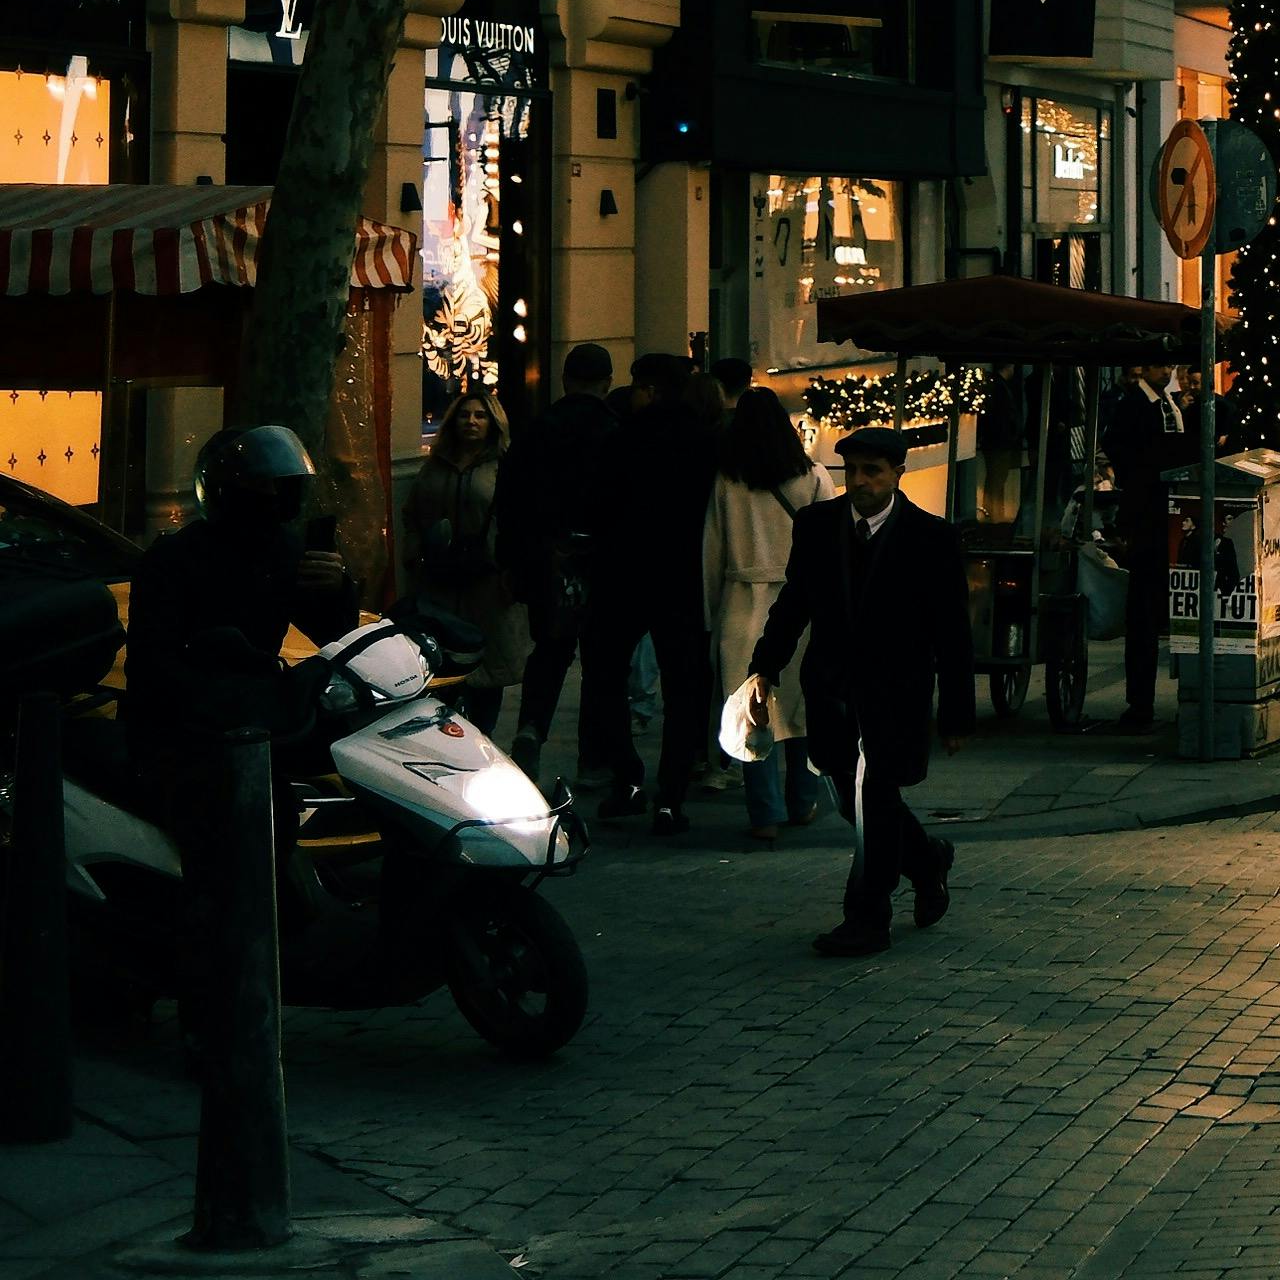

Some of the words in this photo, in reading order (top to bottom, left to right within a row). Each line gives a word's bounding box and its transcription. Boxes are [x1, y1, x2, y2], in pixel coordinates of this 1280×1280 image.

[440, 16, 471, 46] OUIS
[475, 19, 535, 54] VUITTON
[394, 674, 418, 688] HONDA
